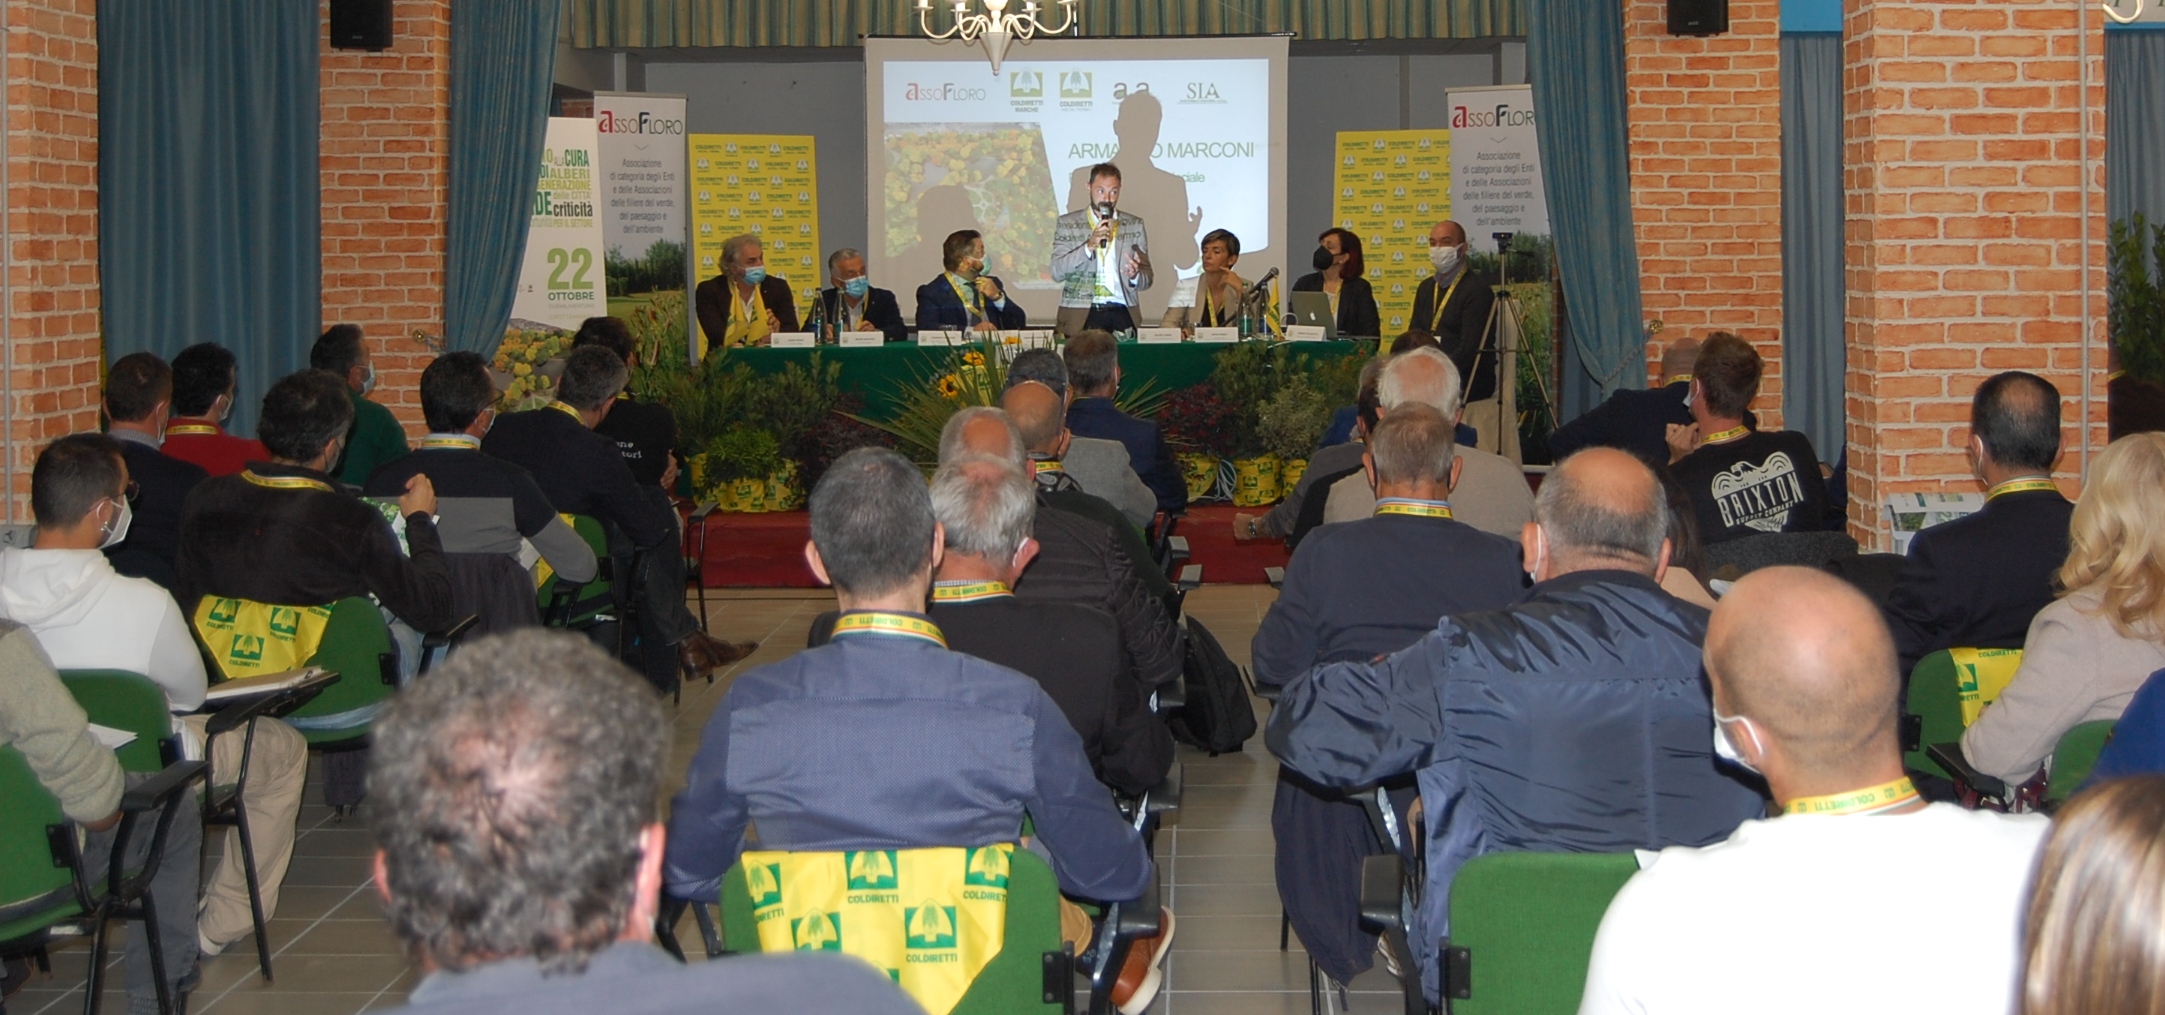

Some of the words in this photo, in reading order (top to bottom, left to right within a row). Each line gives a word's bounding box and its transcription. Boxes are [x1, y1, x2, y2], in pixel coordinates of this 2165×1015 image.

[1187, 83, 1220, 99] SIA
[1168, 142, 1253, 158] MARCONI
[565, 149, 589, 167] CURA
[1477, 152, 1520, 160] Associazione
[623, 159, 661, 167] Associazione
[550, 168, 590, 179] ALBERI
[1463, 165, 1469, 174] di
[1471, 165, 1501, 175] categoria
[1504, 165, 1519, 174] degli
[1522, 164, 1534, 172] Enti
[610, 172, 616, 180] di
[618, 172, 644, 182] categoria
[646, 172, 661, 182] degli
[663, 172, 675, 180] Enti
[1471, 179, 1487, 187] delle
[1490, 177, 1531, 186] Associazioni
[634, 185, 672, 193] Associazioni
[1463, 192, 1479, 200] delle
[611, 199, 625, 207] delle
[554, 201, 593, 217] criticità
[1472, 205, 1483, 213] del
[1485, 205, 1519, 214] paesaggio
[620, 212, 628, 220] del
[630, 213, 661, 222] paesaggio
[1476, 218, 1521, 226] dell'ambiente
[547, 248, 593, 290] 22
[548, 292, 594, 300] OTTOBRE
[1717, 472, 1804, 527] BRIXTON
[1736, 513, 1762, 525] SUPPLY
[1765, 500, 1793, 517] COMPANY
[229, 660, 260, 668] COLDIRETTI
[847, 894, 899, 904] COLDIRETTI
[906, 953, 957, 963] COLDIRETTI
